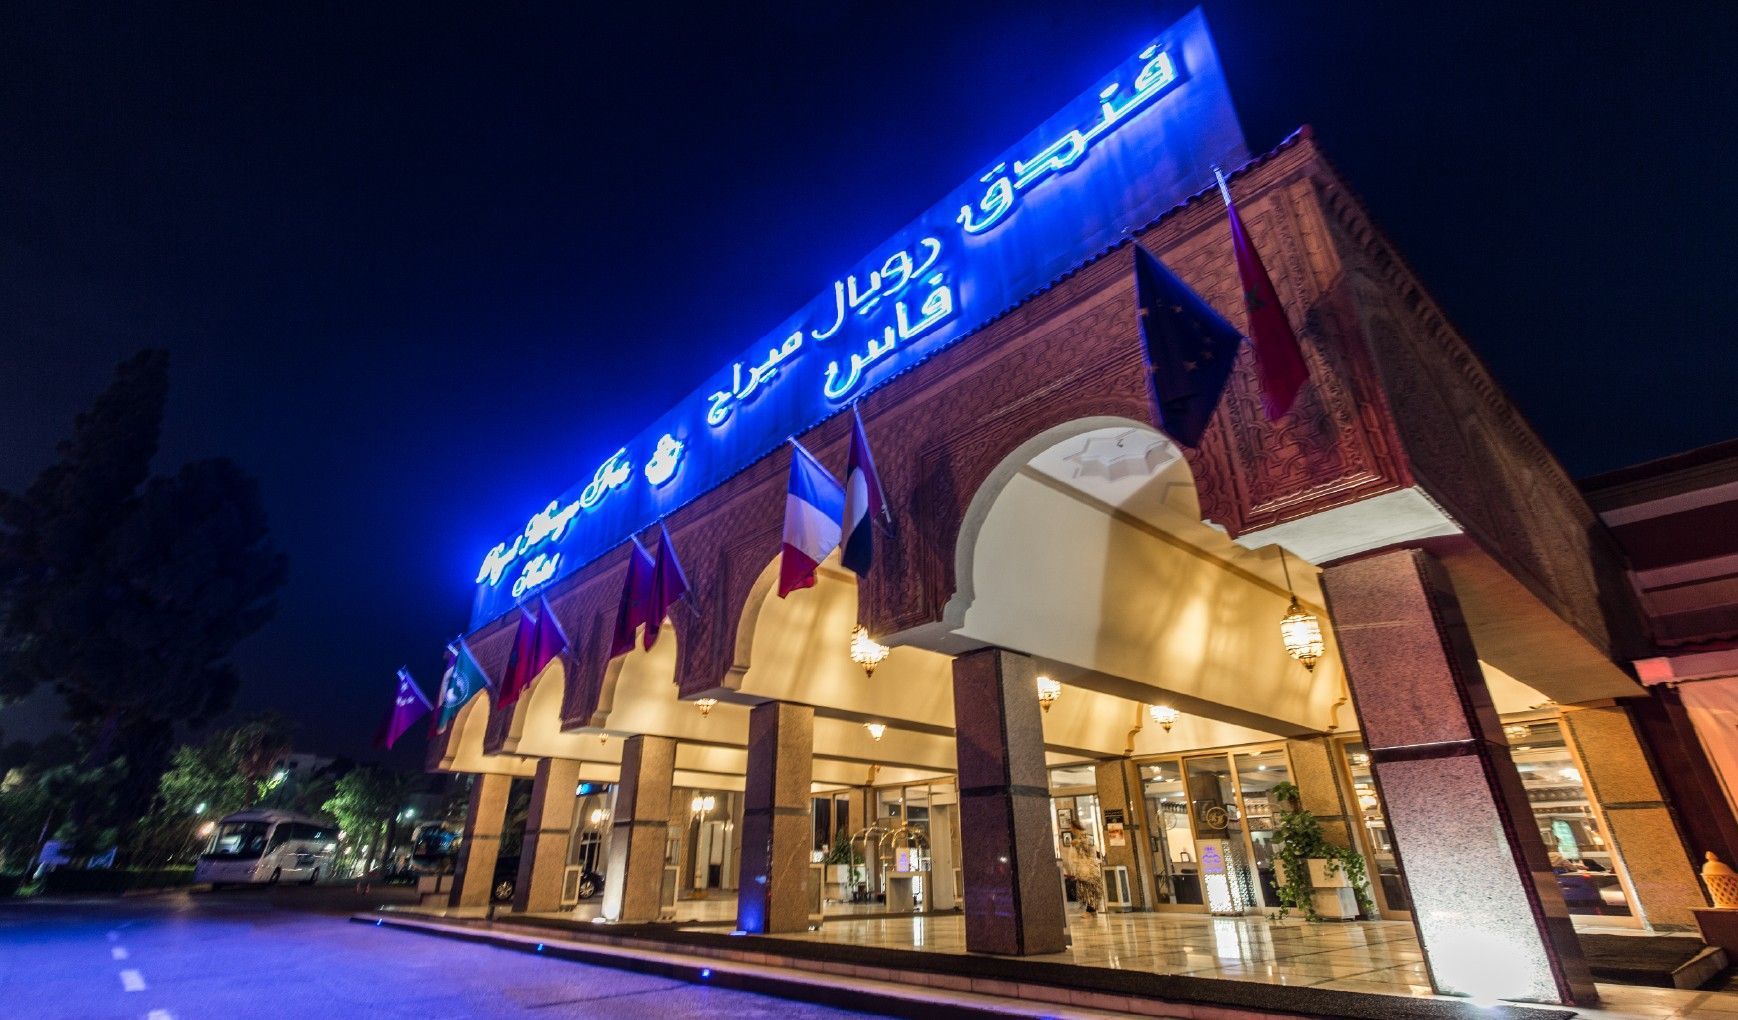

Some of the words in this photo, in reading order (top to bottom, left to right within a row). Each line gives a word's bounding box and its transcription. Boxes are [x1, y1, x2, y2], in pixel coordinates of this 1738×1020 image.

[956, 43, 1177, 233] فندق
[811, 237, 941, 340] رويال
[823, 272, 952, 399] فاس
[707, 331, 803, 426] ميراج
